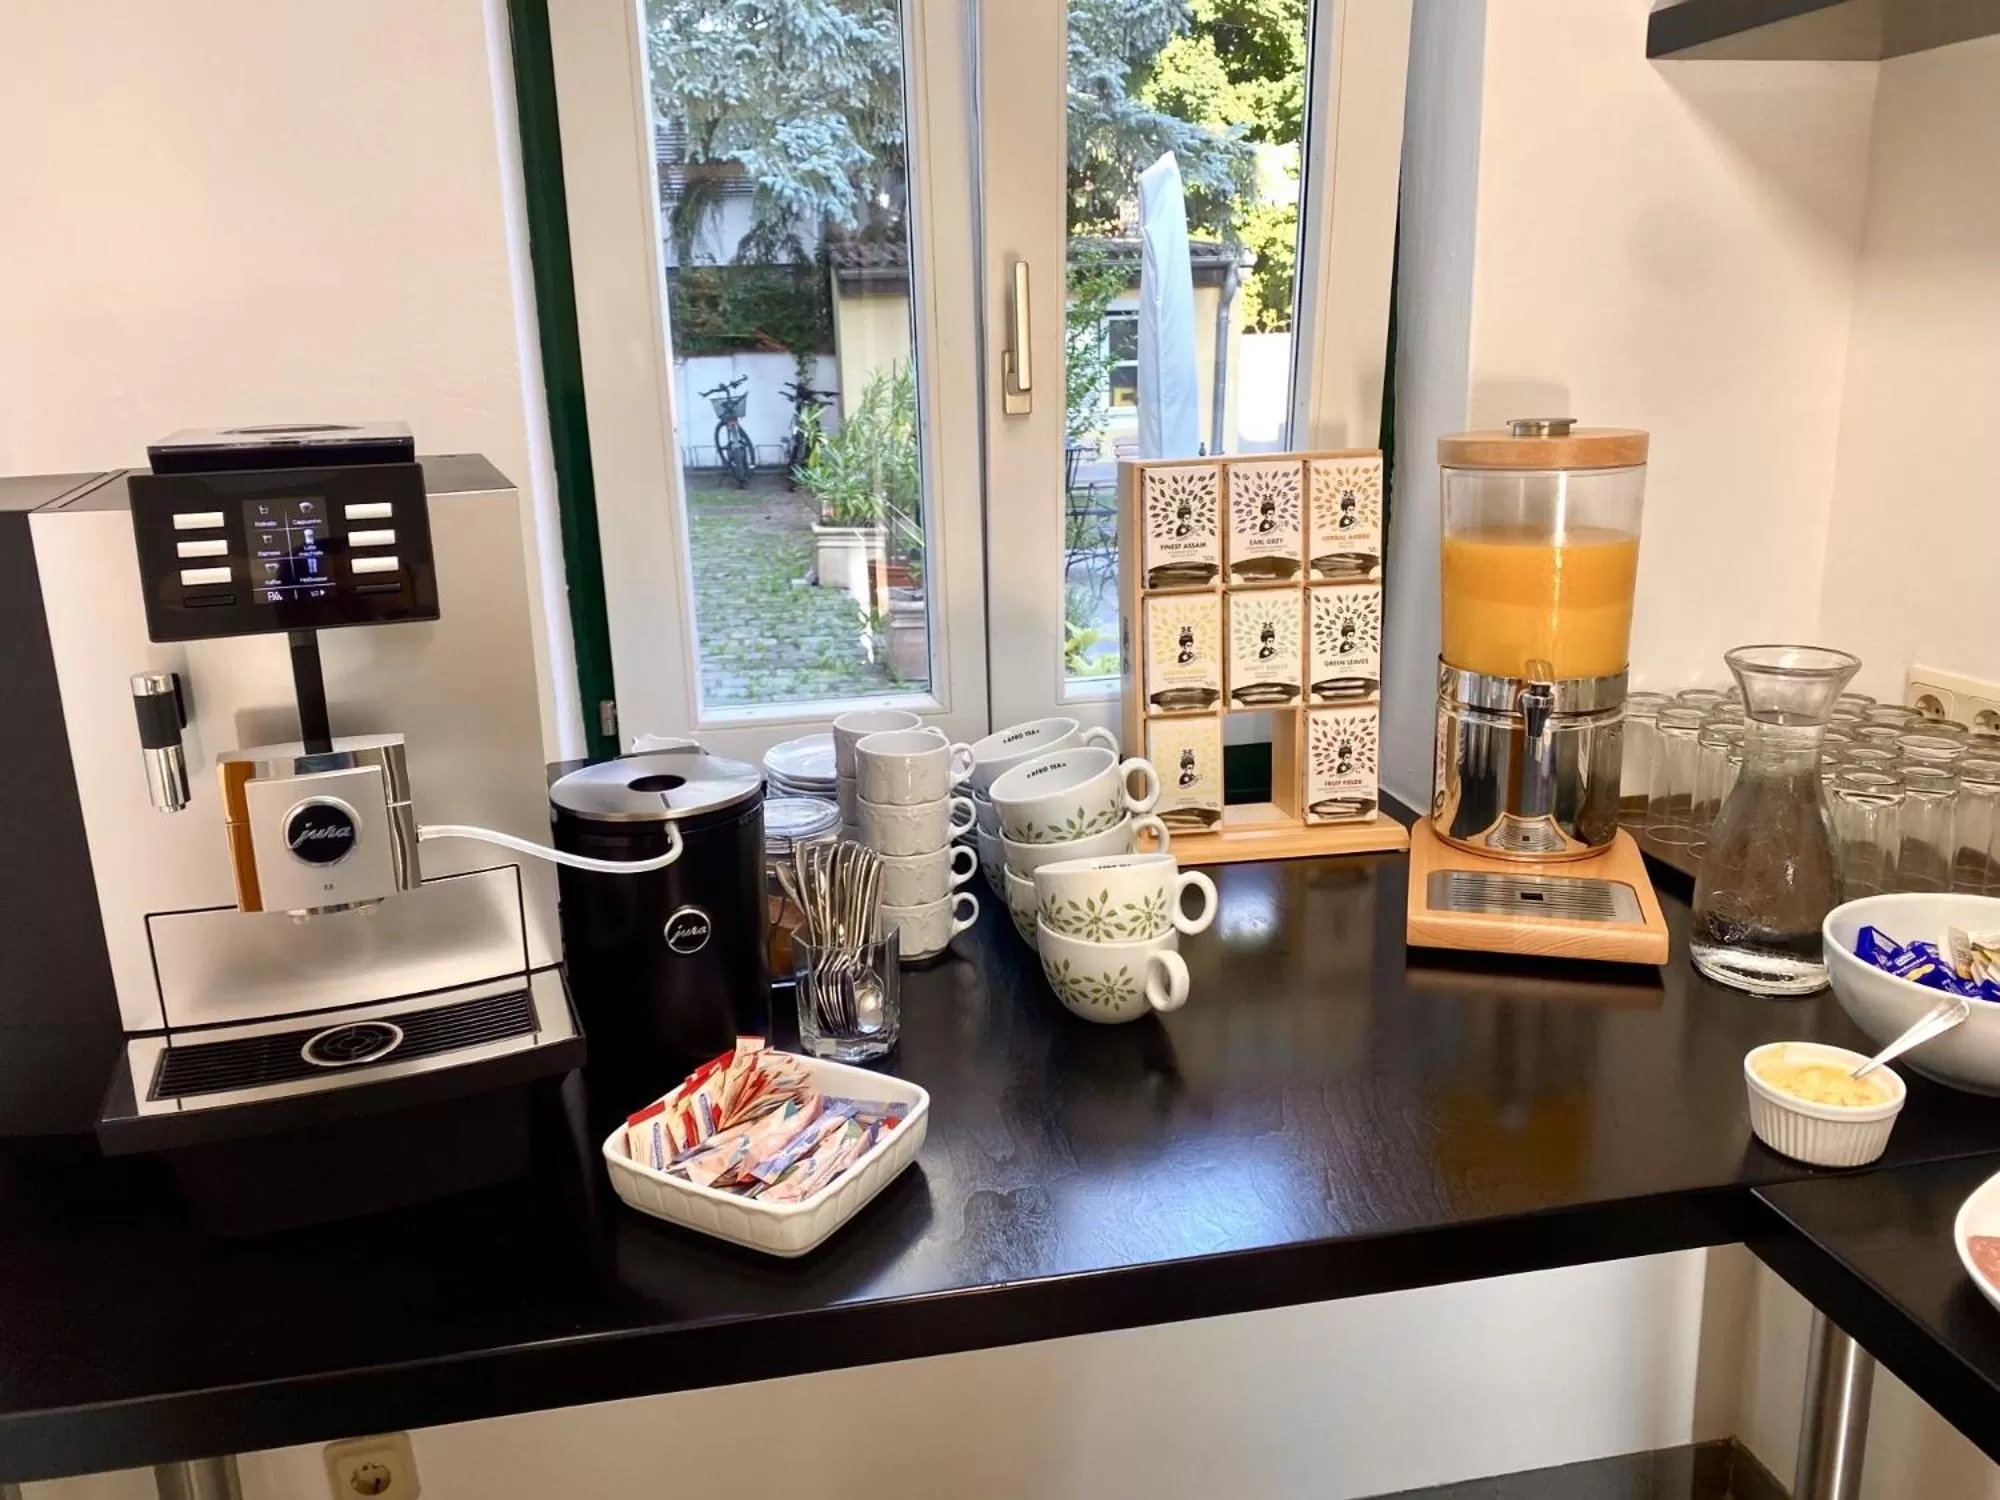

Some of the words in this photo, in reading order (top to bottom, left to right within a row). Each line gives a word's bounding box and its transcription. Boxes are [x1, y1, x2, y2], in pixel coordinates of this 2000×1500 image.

[1160, 543, 1182, 551] FINEST
[1007, 733, 1023, 743] AFRO
[1031, 766, 1048, 777] AFRO
[1050, 762, 1061, 770] TEA
[292, 821, 353, 849] jura
[669, 924, 707, 944] jura
